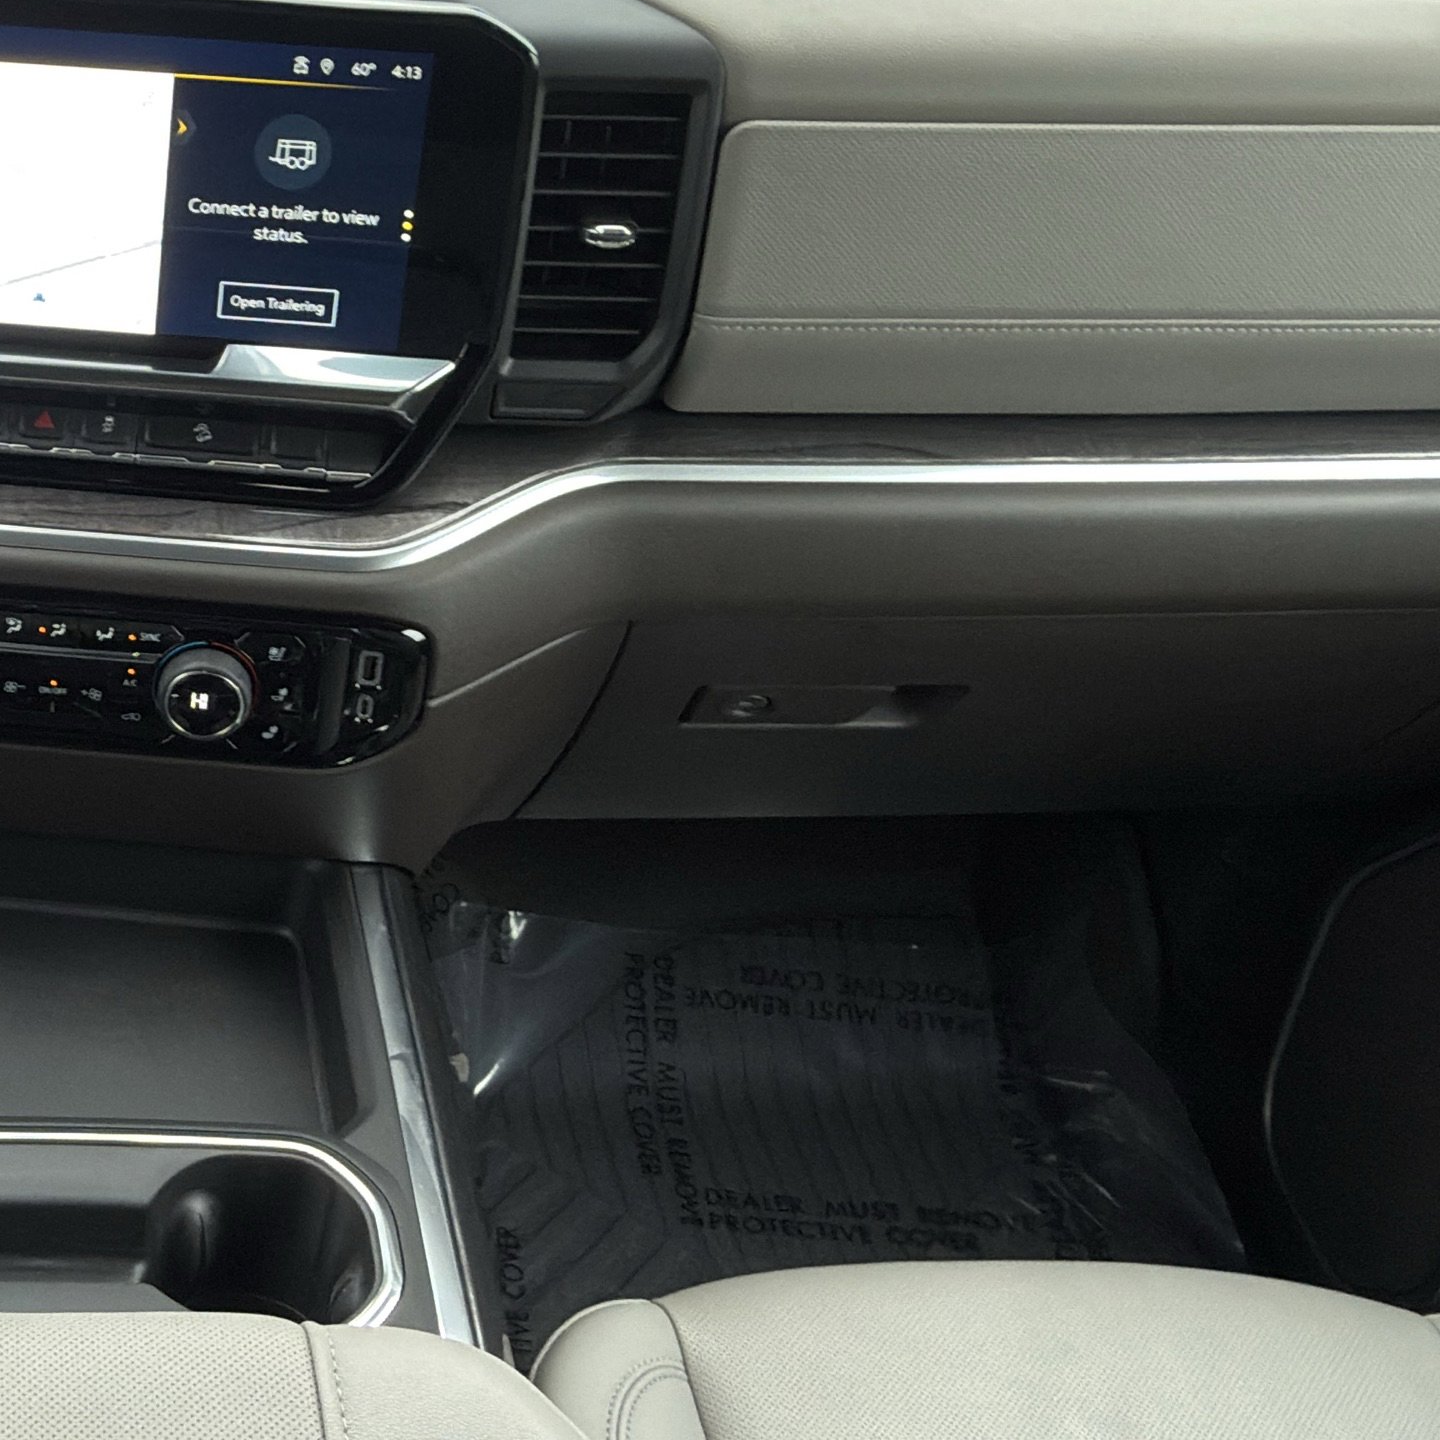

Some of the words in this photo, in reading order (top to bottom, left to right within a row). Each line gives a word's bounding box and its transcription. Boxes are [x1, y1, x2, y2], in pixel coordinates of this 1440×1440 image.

[391, 64, 423, 81] 4:13
[187, 197, 257, 218] Connect
[258, 206, 269, 218] a
[271, 204, 318, 222] trailer
[321, 208, 339, 224] to
[342, 210, 380, 227] view
[253, 226, 308, 244] status.
[230, 294, 266, 311] Open
[267, 297, 326, 317] Trailering
[189, 691, 210, 711] HI
[738, 964, 825, 992] COVER
[652, 954, 679, 1044] DEALER
[685, 986, 791, 1017] REMOVE
[805, 1000, 878, 1026] MUST
[623, 951, 650, 1097] PROTECTIVE
[655, 1061, 684, 1127] MUST
[628, 1097, 662, 1177] COVER
[706, 1187, 805, 1215] DEALER
[824, 1198, 900, 1222] MUST
[707, 1213, 873, 1245] PROTECTIVE
